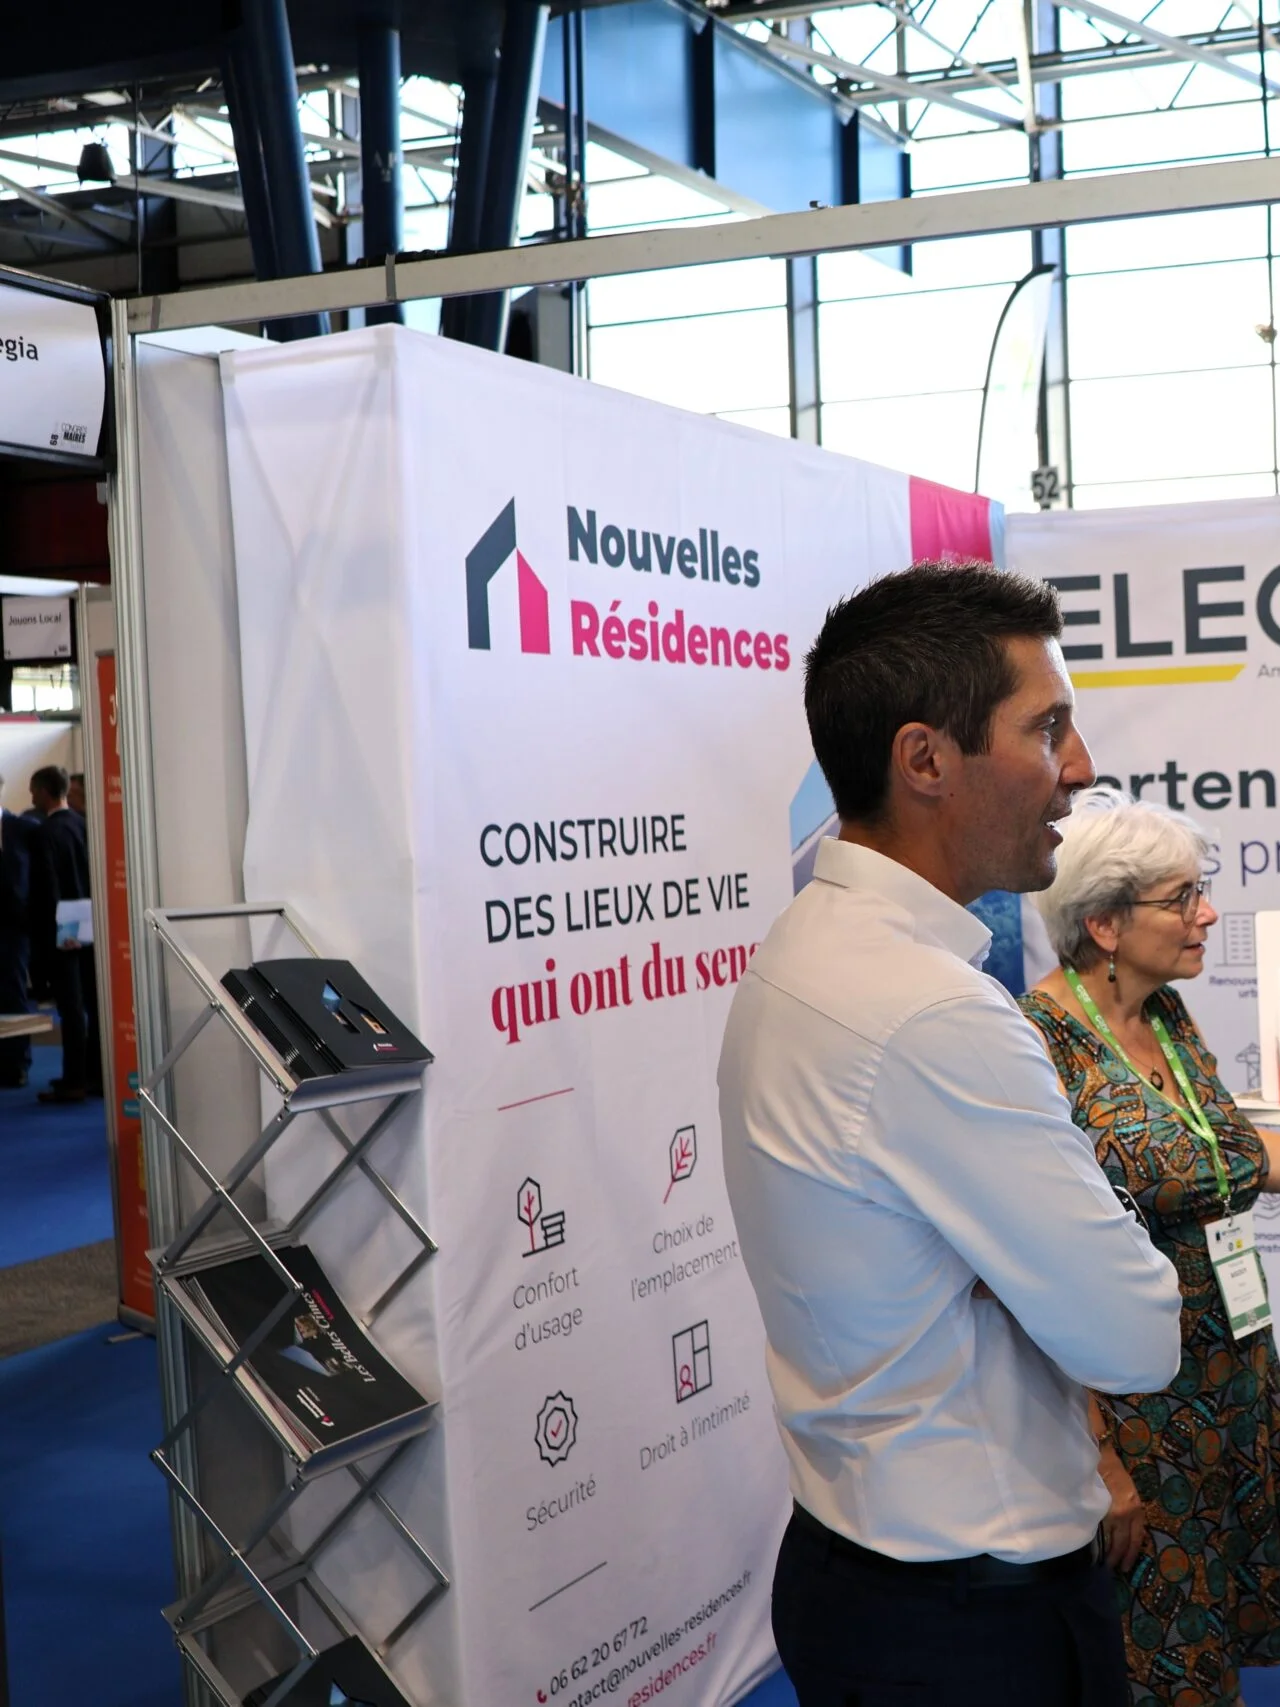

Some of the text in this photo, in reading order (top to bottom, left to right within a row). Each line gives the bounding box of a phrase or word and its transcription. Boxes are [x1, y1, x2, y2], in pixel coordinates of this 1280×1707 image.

[0, 336, 39, 361] gia
[1032, 471, 1058, 500] 52
[566, 505, 761, 588] Nouvelles
[9, 611, 62, 626] Jouons Local
[570, 600, 791, 671] Résidences
[479, 814, 687, 867] CONSTRUIRE
[485, 873, 750, 944] DES LIEUX DE VIE
[491, 958, 560, 1045] qui
[570, 954, 633, 1015] ont
[641, 942, 687, 1001] du
[653, 1215, 714, 1254] Choix de
[512, 1267, 580, 1309] Confort
[630, 1240, 738, 1302] l'emplacement
[514, 1307, 583, 1351] d'usage
[639, 1391, 751, 1471] Droit à l'intimité
[525, 1473, 597, 1531] Sécurité
[549, 1616, 648, 1696] 06 62 20 67 72
